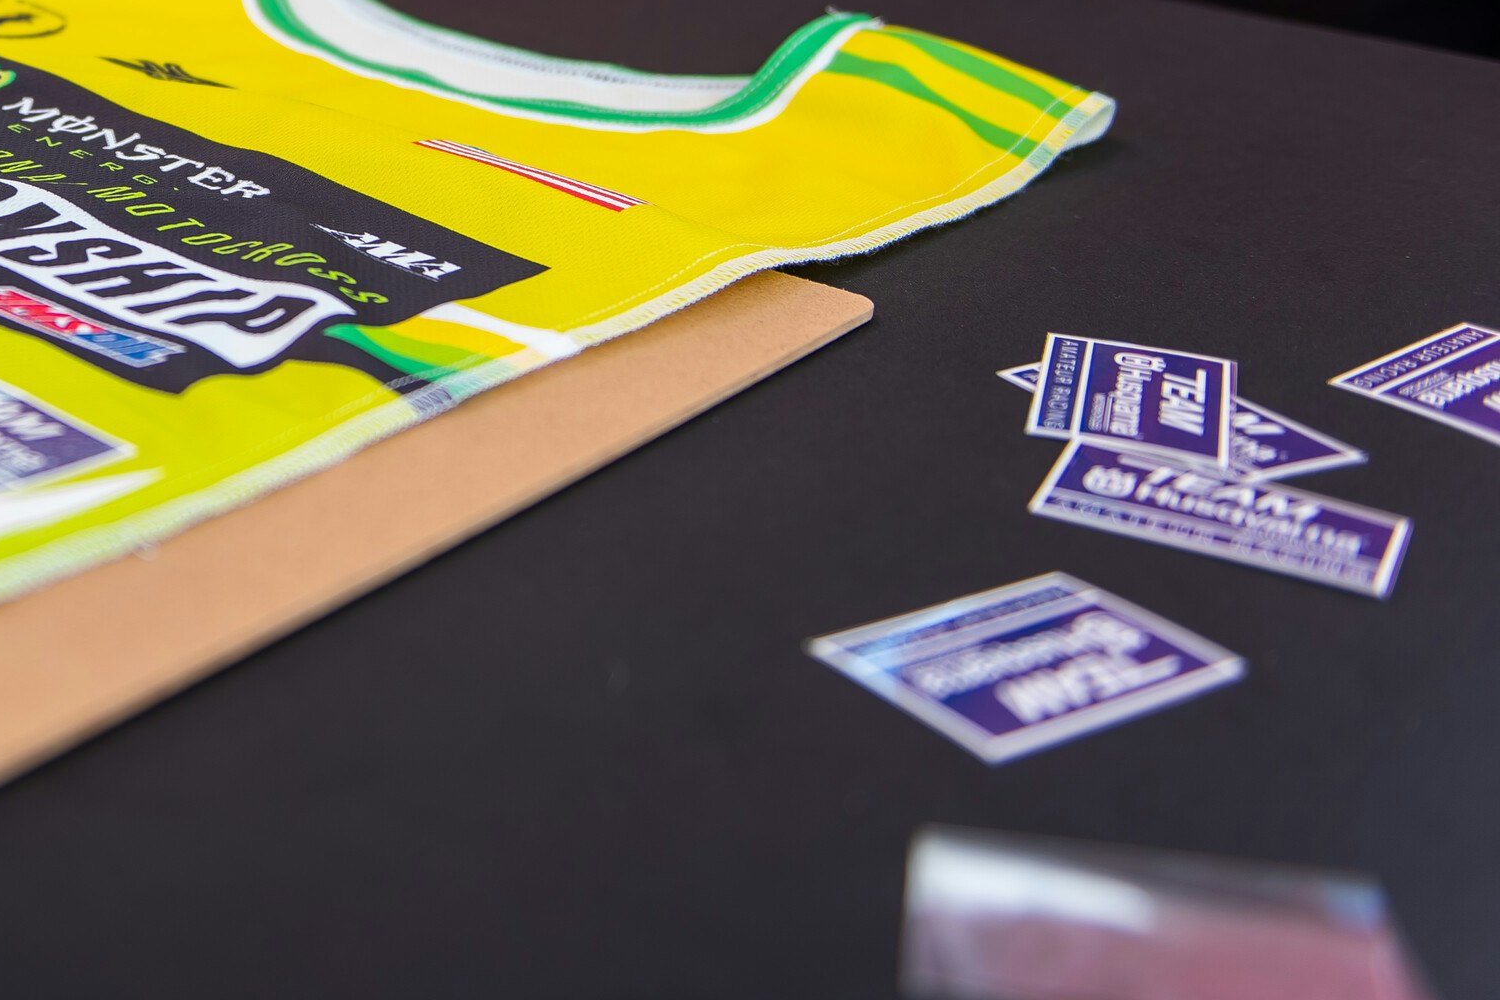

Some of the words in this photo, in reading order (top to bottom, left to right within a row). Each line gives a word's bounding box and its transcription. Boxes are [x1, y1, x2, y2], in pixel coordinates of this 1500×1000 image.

[7, 123, 180, 191] ENERG
[86, 184, 390, 305] MOTOCROSS
[1053, 339, 1080, 386] AMATEUR
[1415, 330, 1485, 362] AMATEUR
[1353, 358, 1418, 389] RACING
[1043, 384, 1073, 431] RACING
[1157, 368, 1207, 437] TEAM
